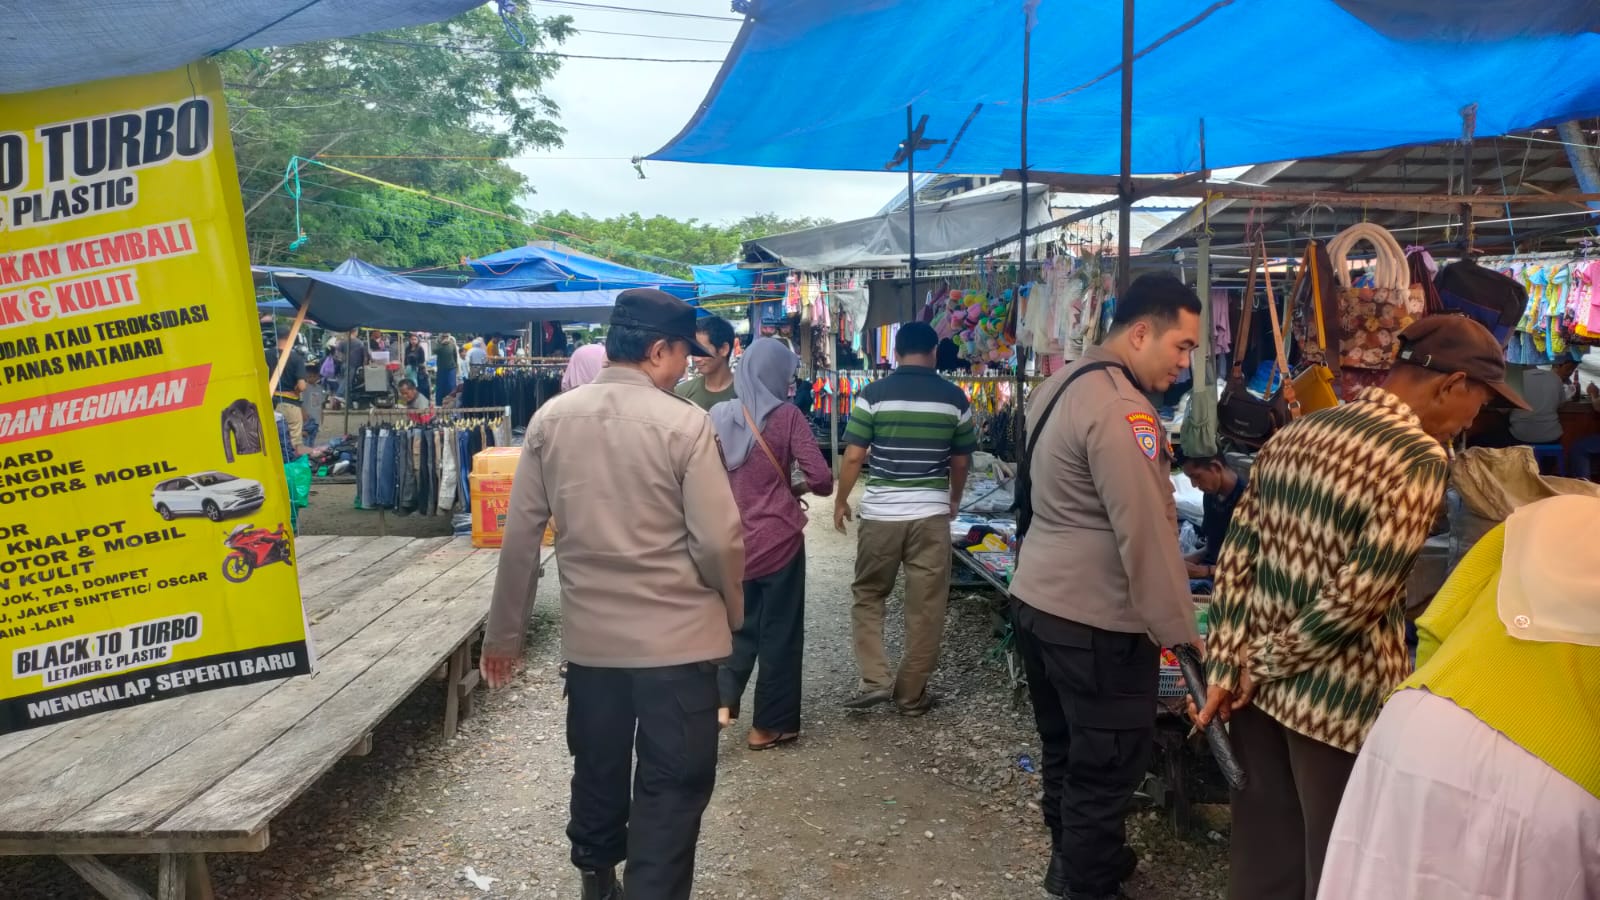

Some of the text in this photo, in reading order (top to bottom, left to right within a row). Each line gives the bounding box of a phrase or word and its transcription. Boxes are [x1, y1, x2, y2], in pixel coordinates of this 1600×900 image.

[41, 99, 210, 183] TURBO
[13, 176, 134, 226] PLASTIC
[66, 223, 193, 272] KEMBALI
[56, 273, 134, 314] KULIT
[45, 325, 92, 352] ATAU
[94, 304, 209, 342] TEROKSIDASI
[4, 337, 164, 385] PANAS MATAHARI
[0, 378, 188, 438] DAN KEGUNAAN
[0, 449, 54, 471] ARD
[95, 460, 178, 487] MOBIL
[7, 520, 126, 555] KNALPOT
[78, 545, 95, 559] &
[104, 526, 187, 553] MOBIL
[2, 568, 149, 607] JOK, TAS, DOMPET
[17, 600, 68, 620] JAKET
[157, 572, 208, 590] OSCAR
[19, 560, 96, 588] KULIT
[18, 615, 199, 675] BLACK TO TURBO
[48, 660, 101, 683] LETAHER
[117, 646, 167, 668] PLASTIC
[27, 651, 297, 720] MENGKILAP SEPERTI BARU
